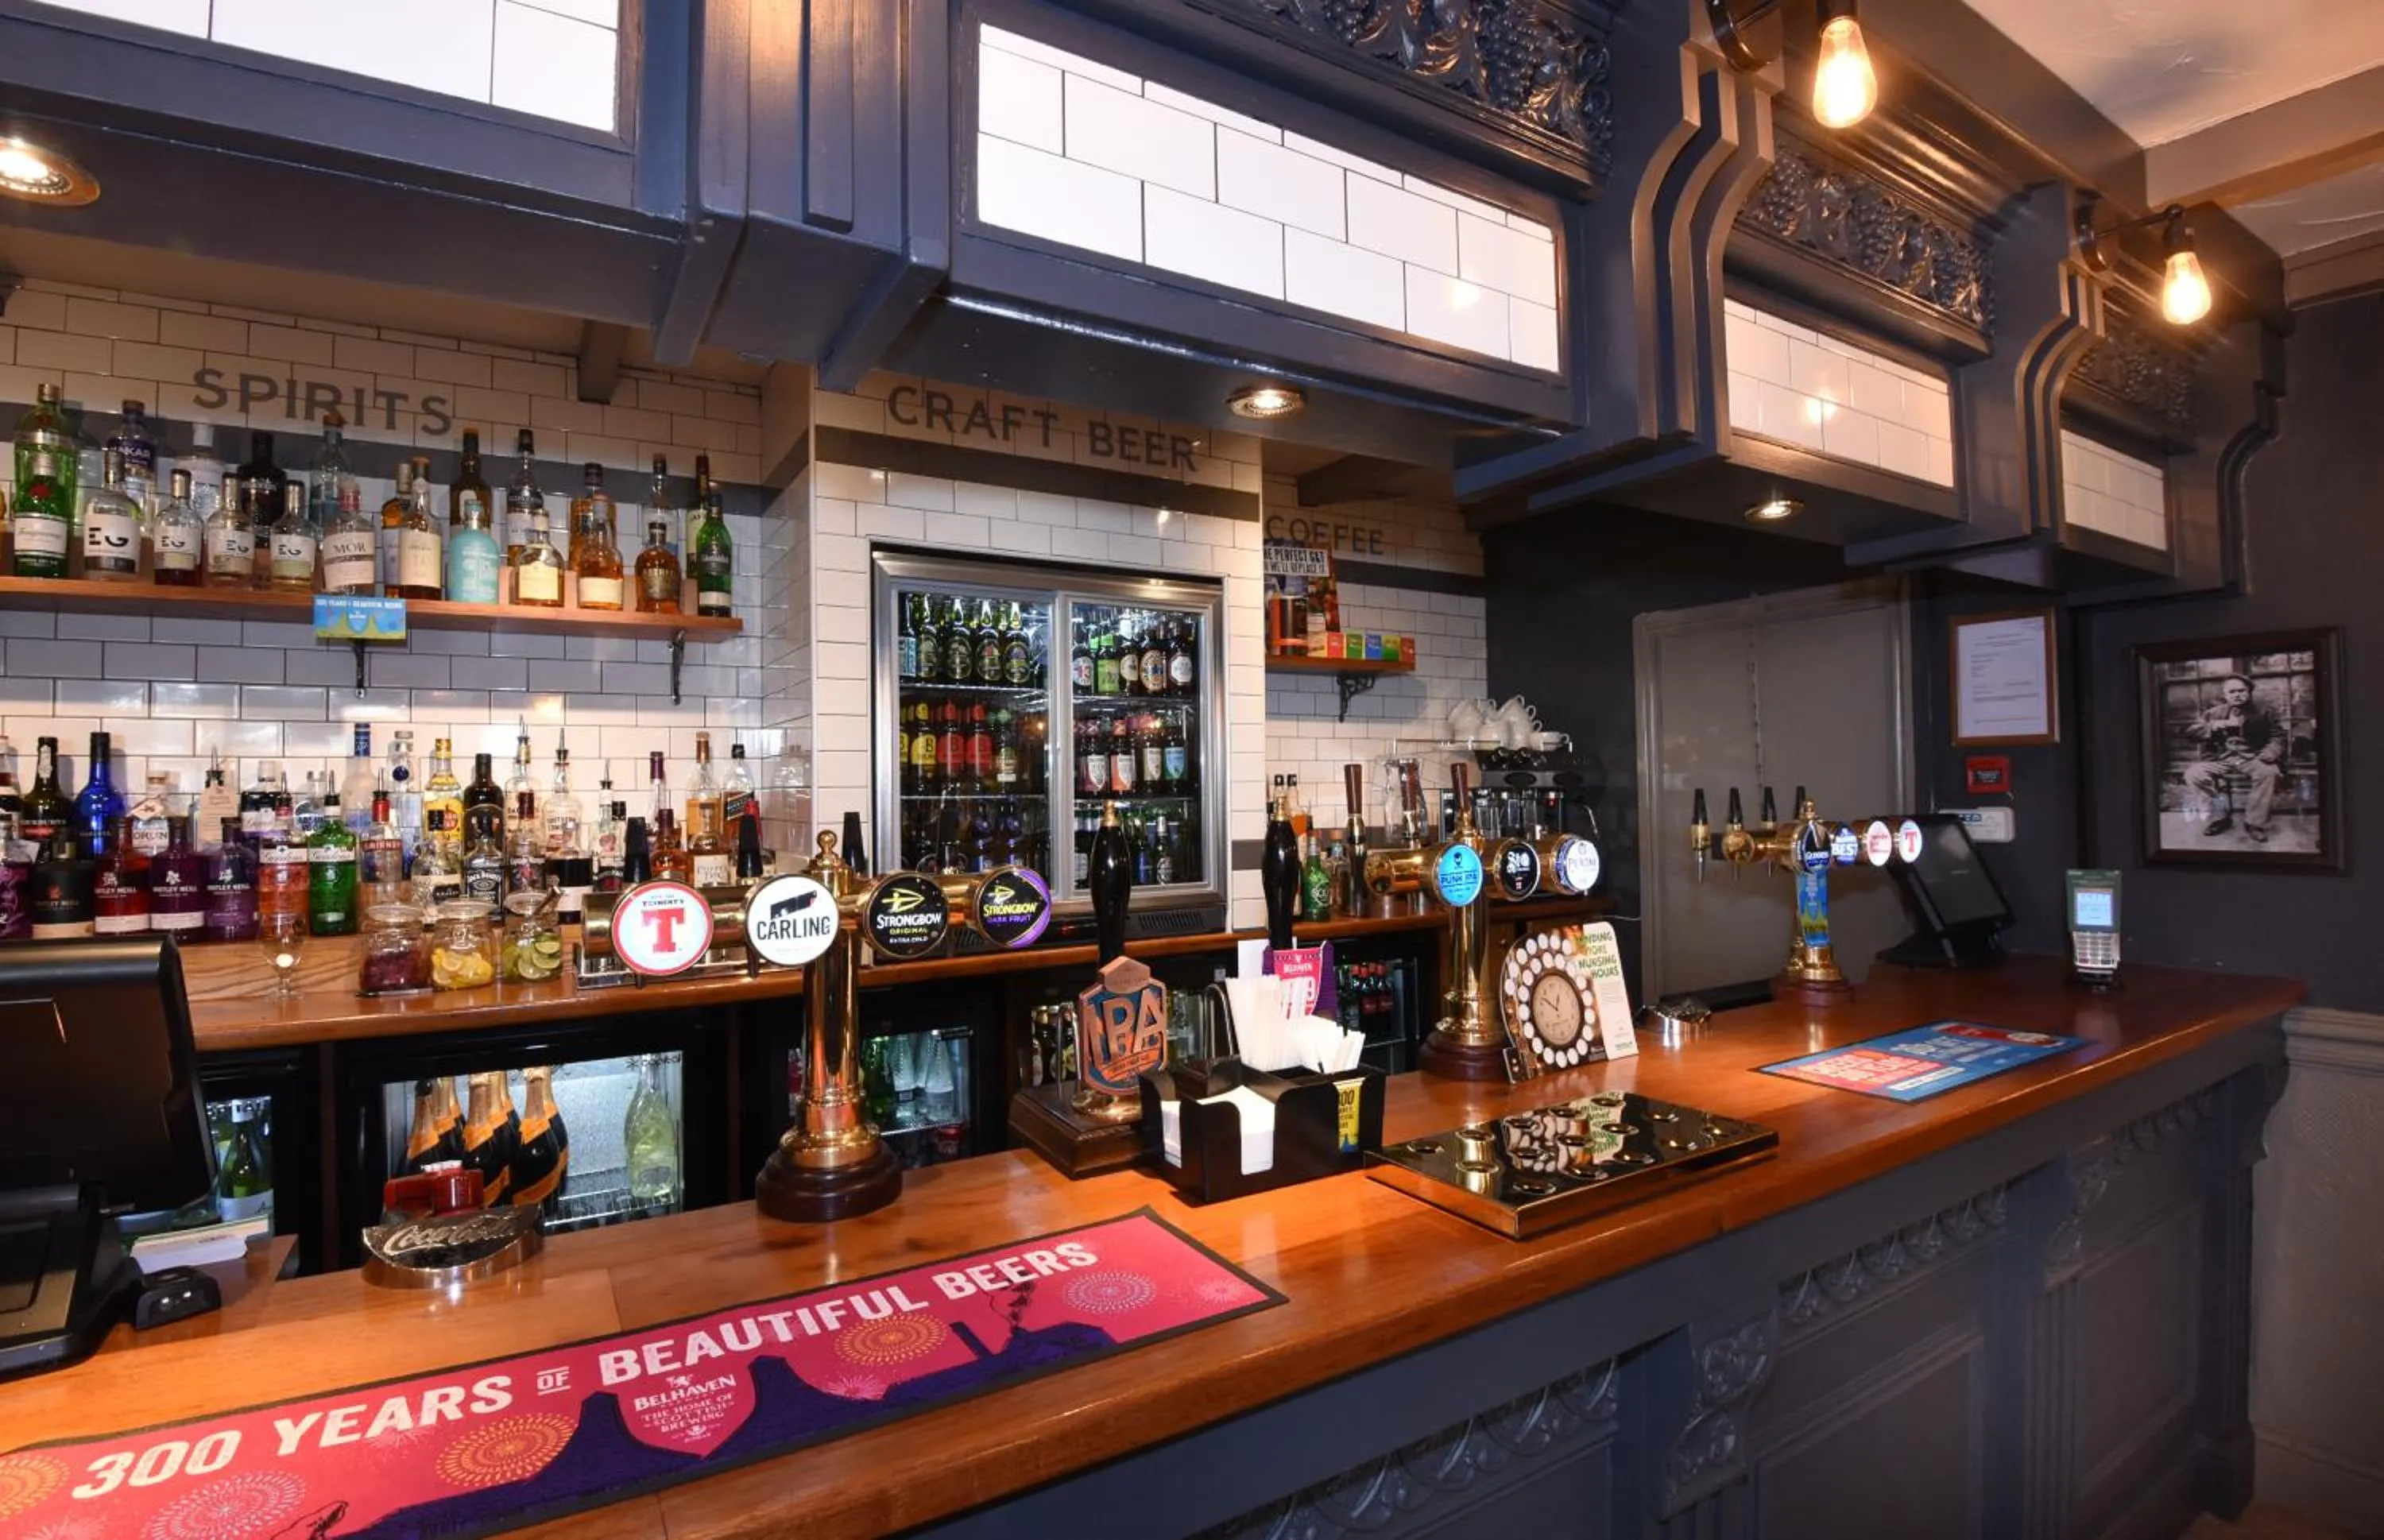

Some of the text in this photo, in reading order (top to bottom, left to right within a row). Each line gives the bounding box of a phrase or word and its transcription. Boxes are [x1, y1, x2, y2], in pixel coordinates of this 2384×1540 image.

[192, 368, 452, 436] SPIRITS
[888, 385, 1197, 472] CRAFT BEER
[1266, 515, 1384, 555] COFFEE
[334, 543, 366, 554] MOR
[1831, 843, 1857, 856] BEST
[1441, 875, 1463, 884] PUNK
[983, 903, 1038, 916] STRONGBOW
[641, 907, 685, 954] T
[757, 916, 830, 940] CARLING
[877, 913, 942, 930] STRONGBOW
[72, 1241, 1098, 1500] 300 YEARS OF BEAUTIFUL BEERS
[634, 1374, 737, 1411] BELHAVEN
[642, 1410, 669, 1422] THE
[674, 1399, 712, 1414] HOME
[661, 1412, 724, 1433] BREWING
